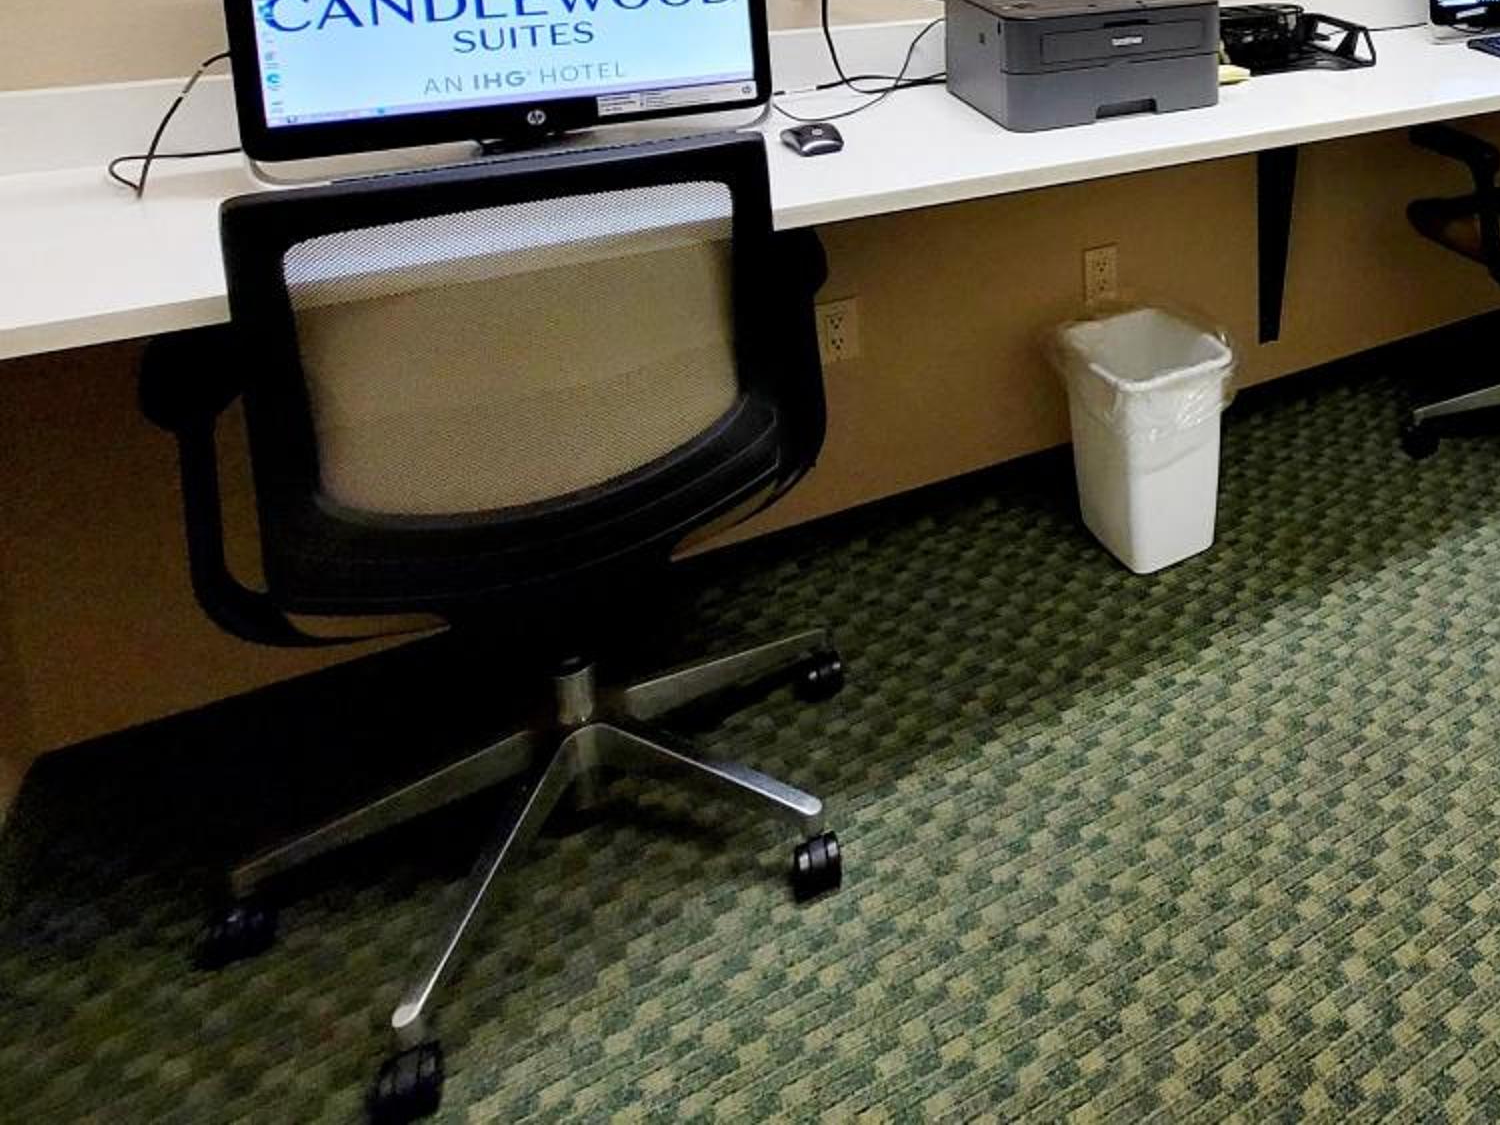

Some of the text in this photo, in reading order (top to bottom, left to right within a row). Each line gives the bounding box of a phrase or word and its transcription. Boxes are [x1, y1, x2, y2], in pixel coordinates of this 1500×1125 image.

[452, 21, 595, 54] SUITES
[422, 61, 628, 95] AN IHG HOTEL
